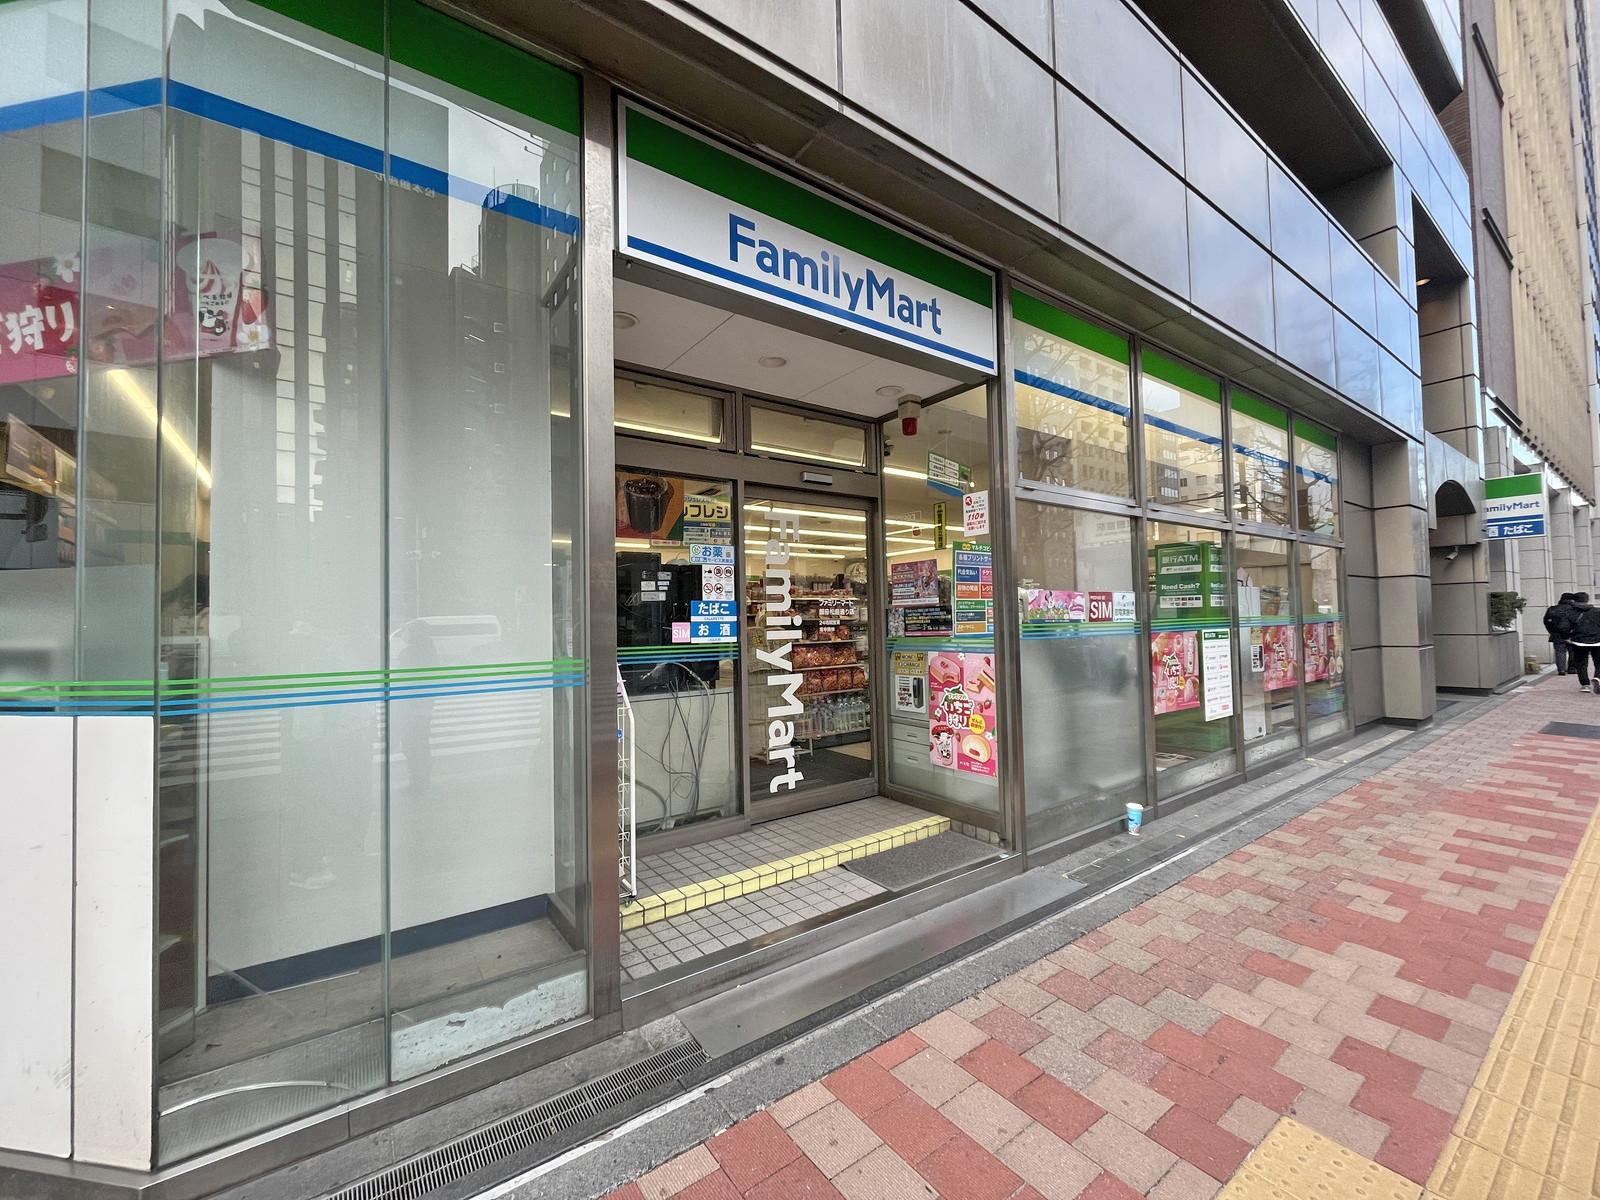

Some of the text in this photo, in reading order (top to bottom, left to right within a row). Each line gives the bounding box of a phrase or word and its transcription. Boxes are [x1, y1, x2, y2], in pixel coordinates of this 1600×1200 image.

[728, 213, 942, 336] FamilyMart
[0, 301, 75, 354] 狩り
[1504, 525, 1533, 535] たばこ
[702, 546, 723, 558] お薬
[1162, 554, 1199, 564] 銀行ATM
[1161, 582, 1201, 591] Need Cash?
[697, 602, 731, 615] たばこ
[819, 599, 854, 608] ファミリーマート
[1090, 600, 1113, 620] SIM
[673, 628, 690, 640] SIM
[757, 510, 804, 794] FamilyMart
[943, 700, 973, 715] いちご
[948, 713, 968, 727] 狩り
